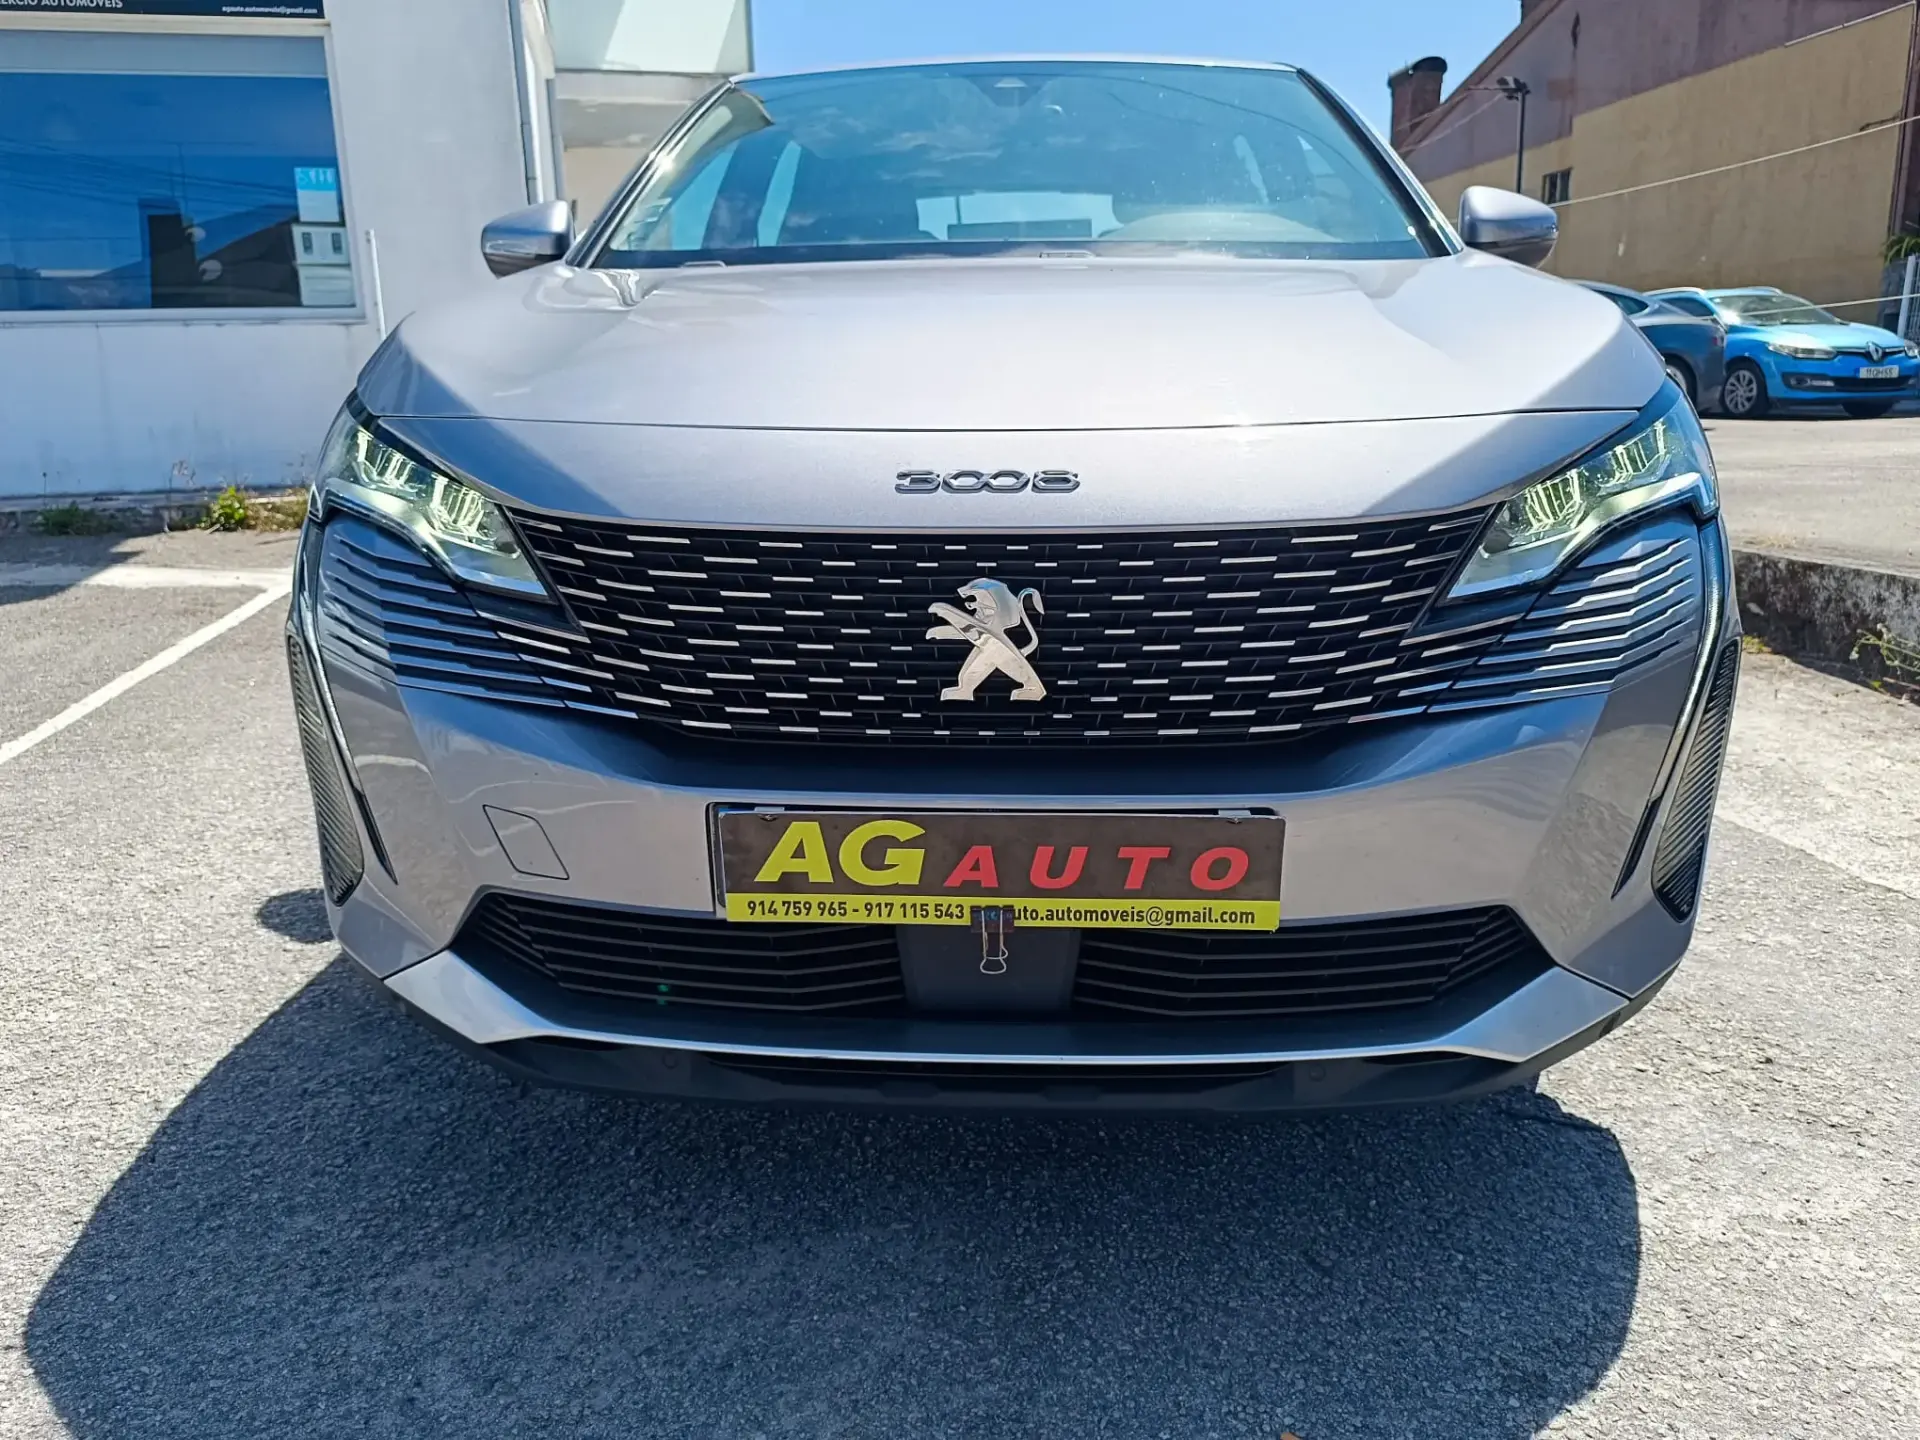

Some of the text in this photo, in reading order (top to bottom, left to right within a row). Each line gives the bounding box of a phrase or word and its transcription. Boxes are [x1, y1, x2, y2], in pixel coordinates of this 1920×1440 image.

[895, 470, 1081, 494] 3008
[754, 819, 1249, 891] AG AUTO
[747, 900, 778, 915] 914
[782, 901, 812, 916] 759
[817, 902, 848, 917] 965
[864, 903, 894, 918] 917
[900, 904, 930, 918] 115
[934, 904, 964, 919] 543
[1013, 905, 1256, 926] uto.automoveis@gmail.com
